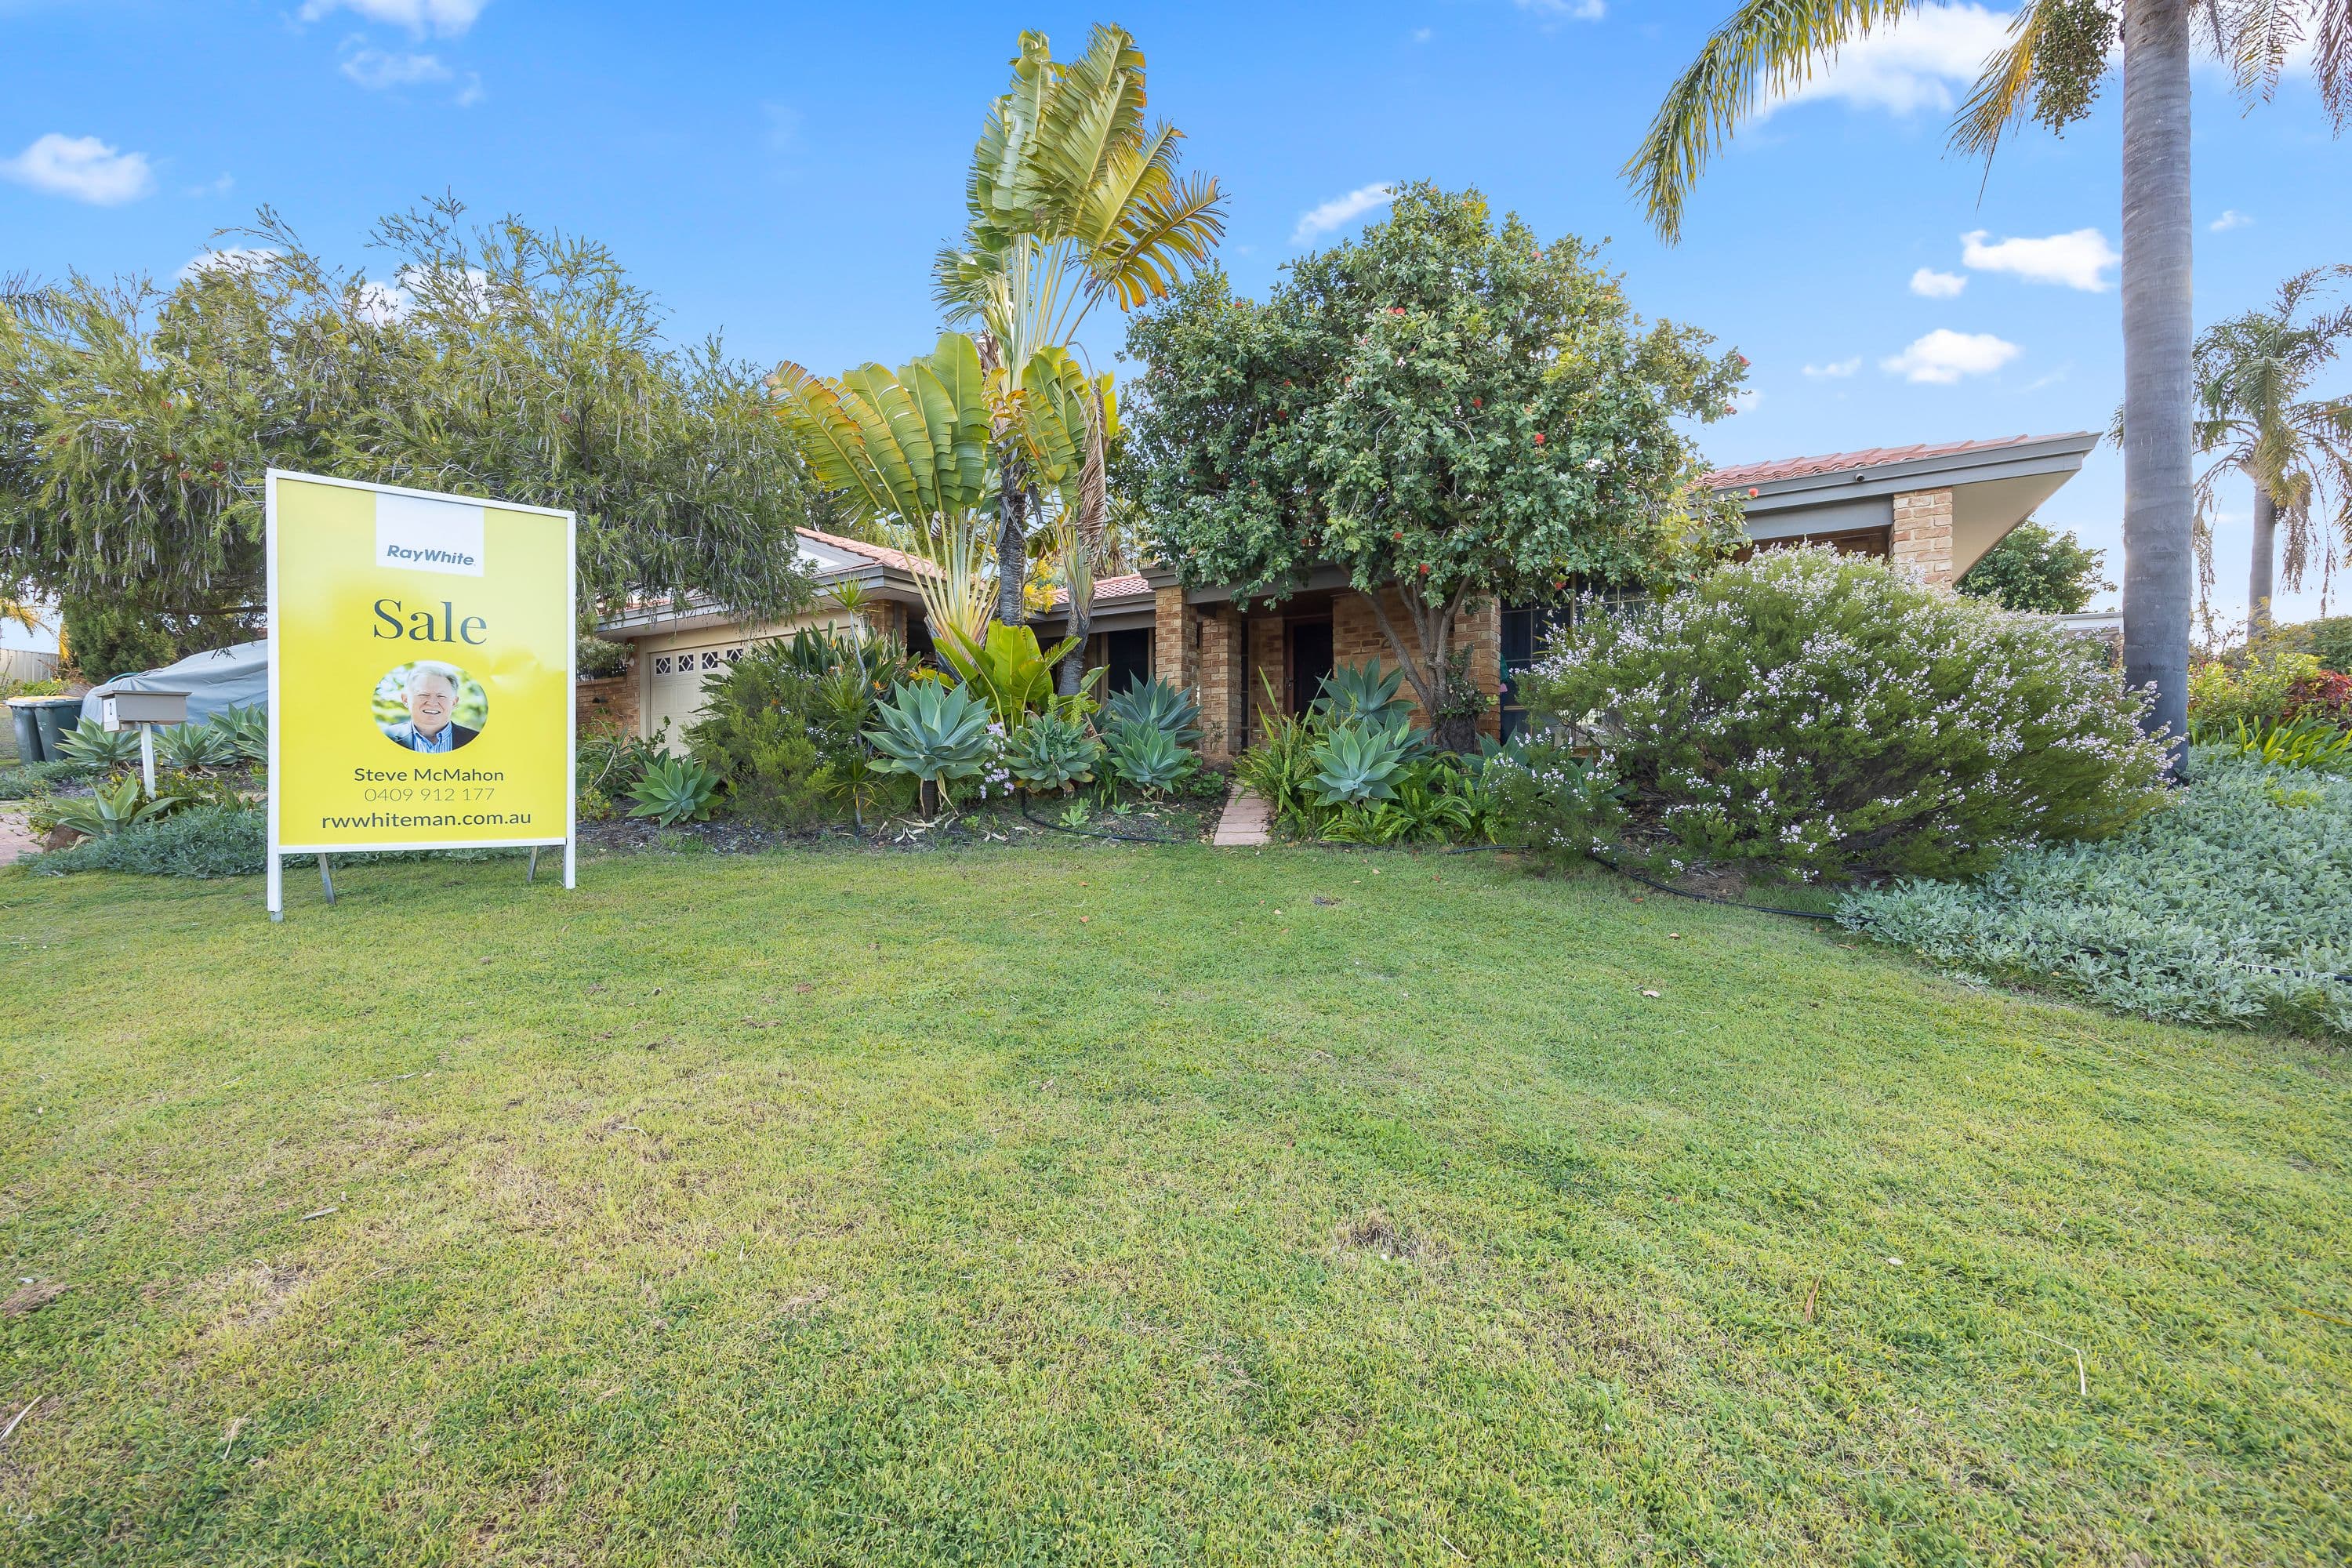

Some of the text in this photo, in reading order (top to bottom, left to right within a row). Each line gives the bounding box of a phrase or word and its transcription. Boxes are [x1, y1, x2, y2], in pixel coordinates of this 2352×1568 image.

[373, 598, 487, 645] Sale
[354, 768, 504, 782] Steve McMahon
[365, 788, 495, 802] 0409 912 177
[322, 811, 531, 829] rwwhiteman.com.au
